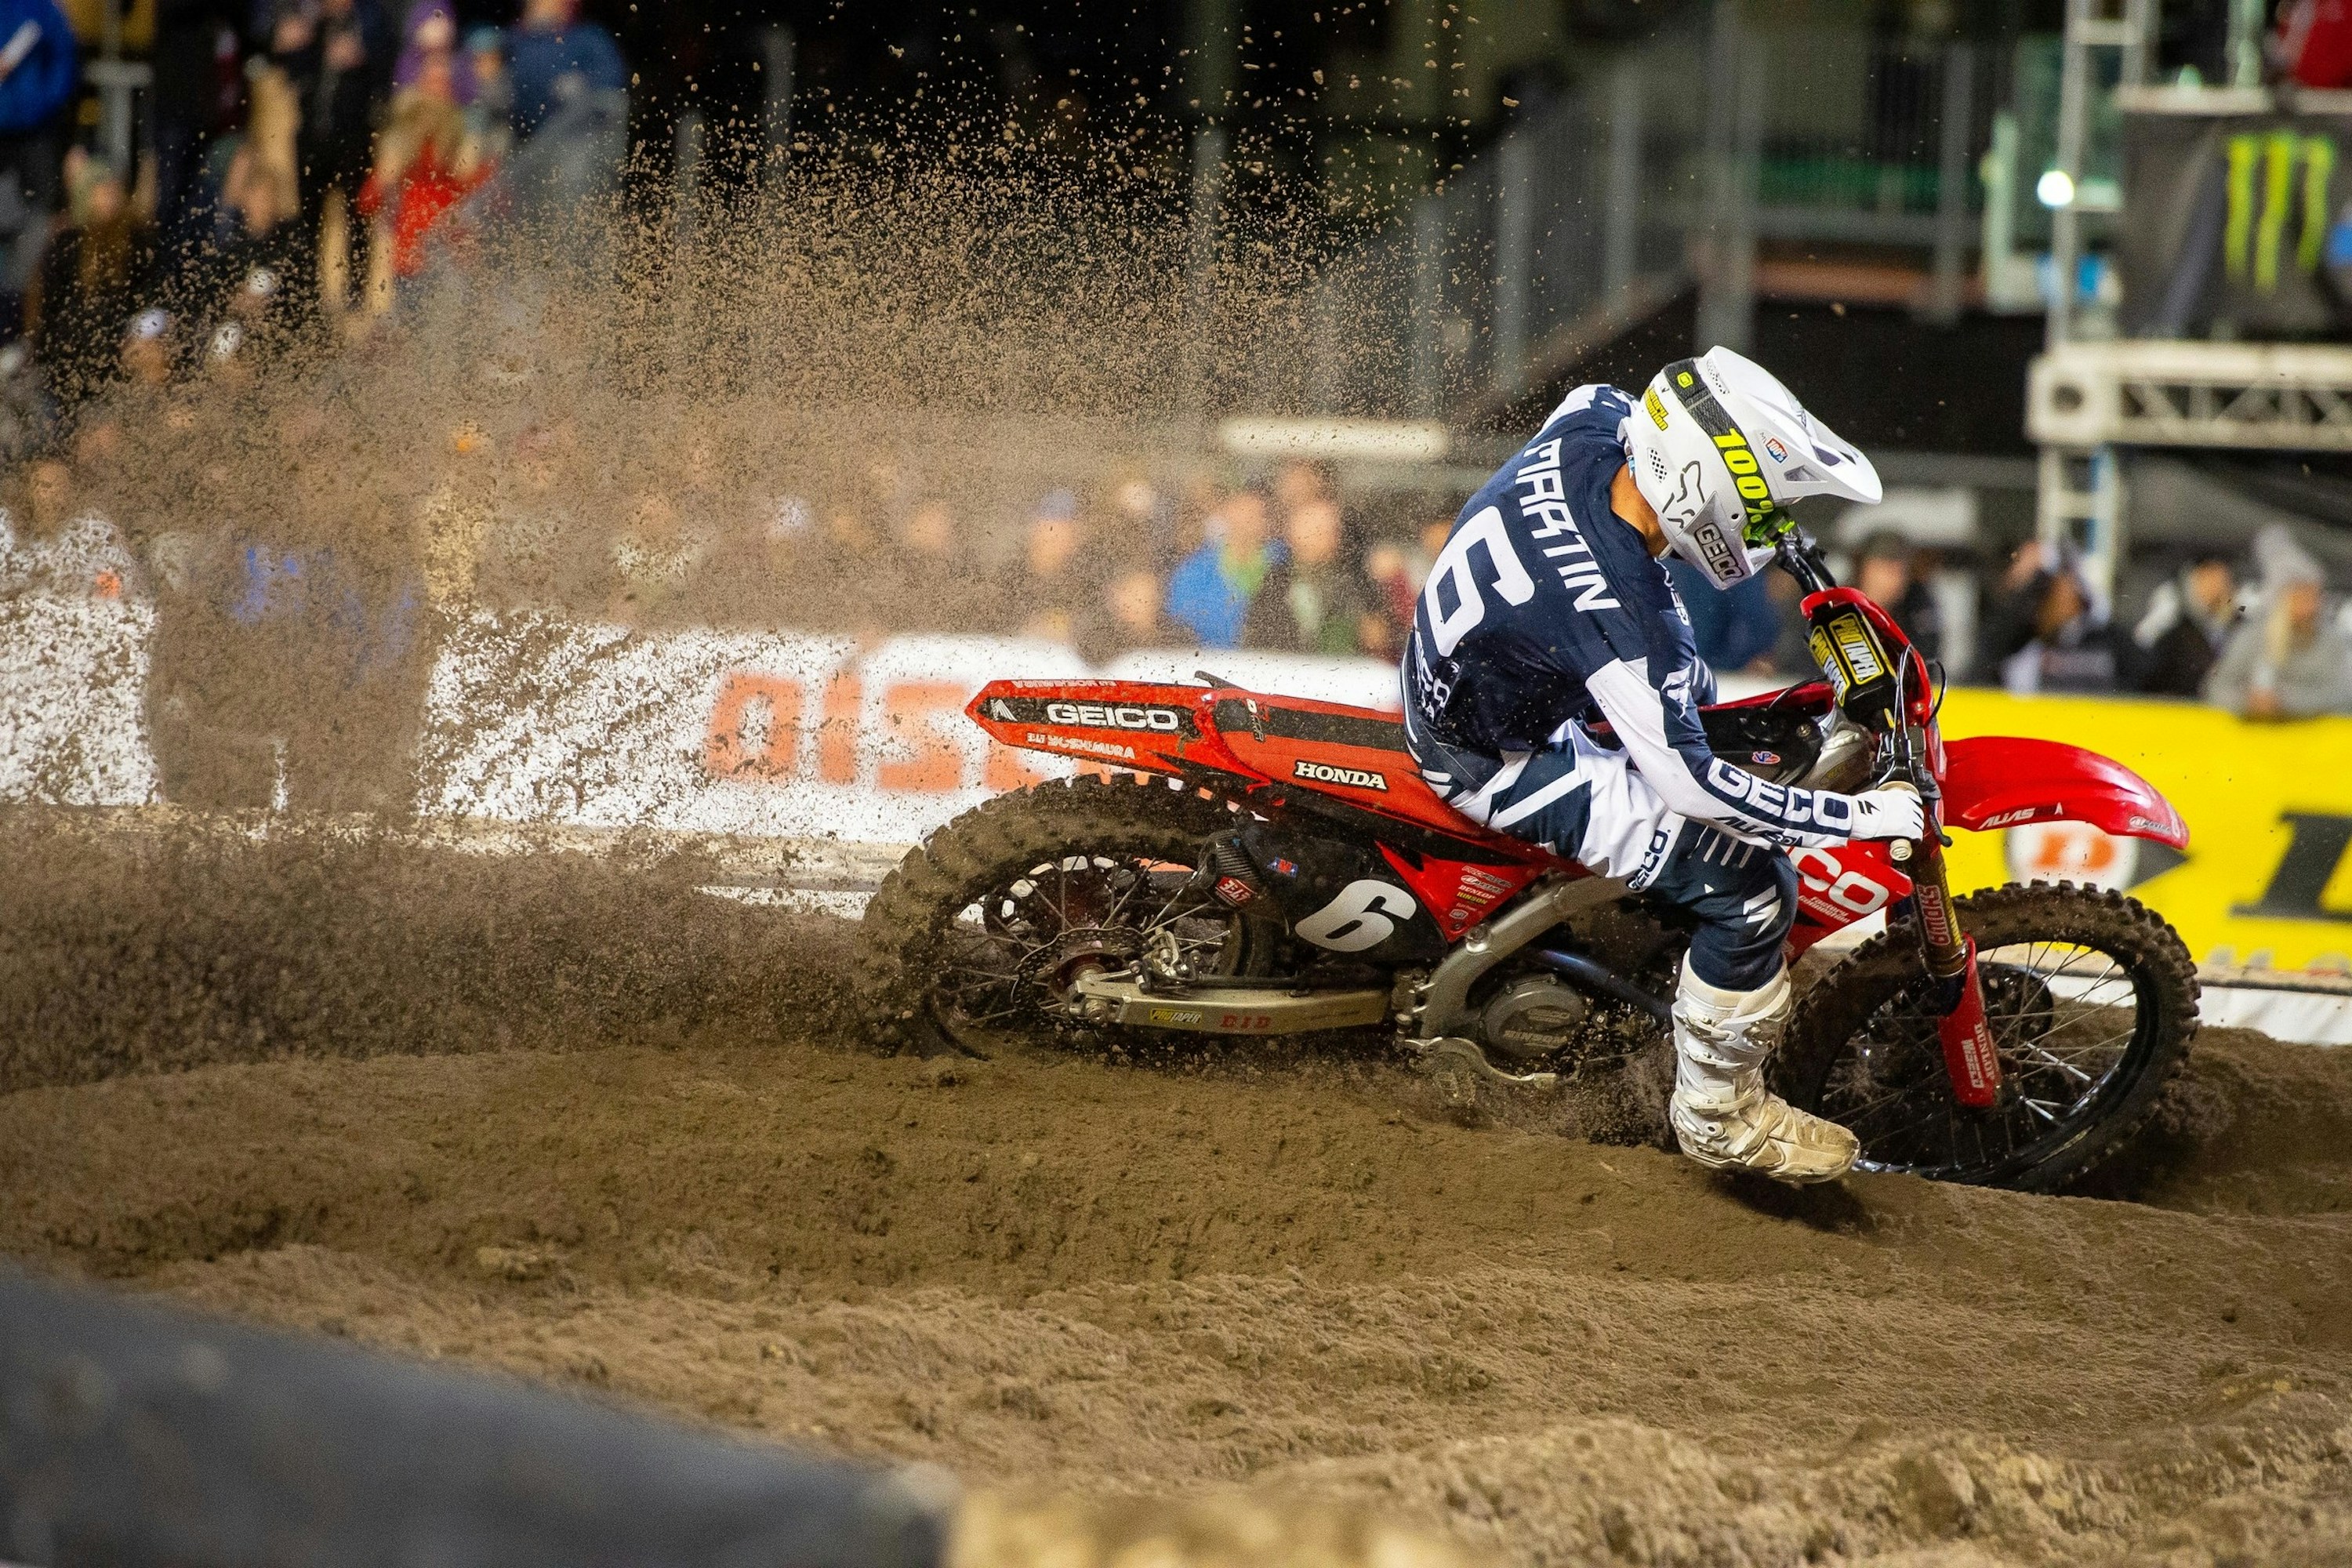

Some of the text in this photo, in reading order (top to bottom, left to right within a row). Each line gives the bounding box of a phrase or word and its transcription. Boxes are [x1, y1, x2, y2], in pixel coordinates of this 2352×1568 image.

[1713, 427, 1774, 524] 100%
[1767, 439, 1788, 463] 100%
[1515, 437, 1621, 613] MARTIN
[1694, 522, 1744, 582] GEICO
[1425, 506, 1536, 658] 6
[1046, 703, 1179, 730] GEICO
[1047, 735, 1136, 760] YOSHIMURA
[1294, 760, 1388, 790] HONDA
[1294, 879, 1417, 952] 6
[1458, 884, 1496, 900] DUNLOP
[1916, 884, 1951, 946] SHOWA
